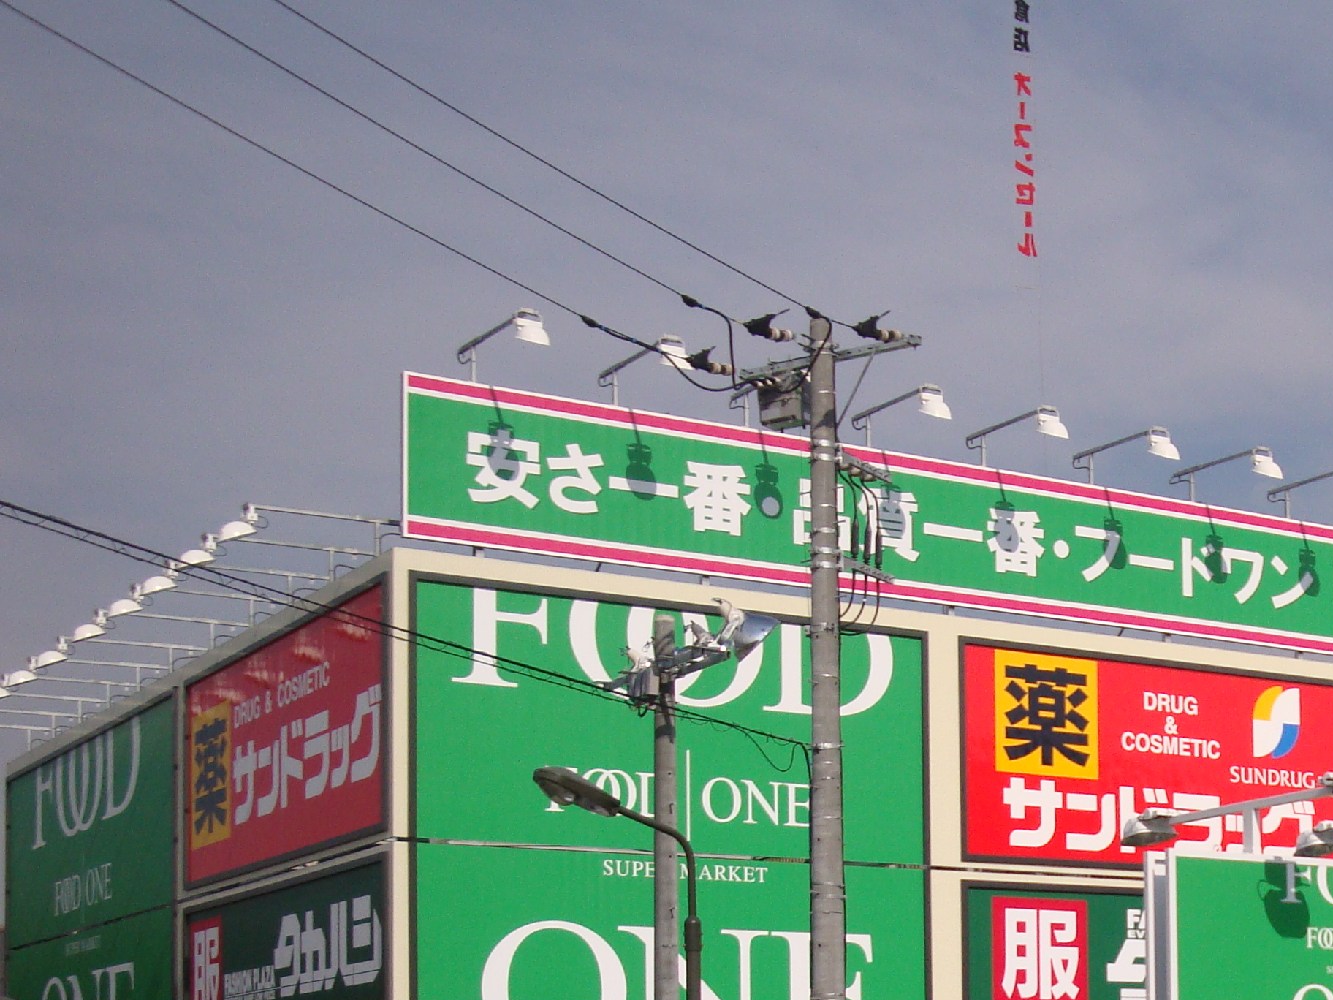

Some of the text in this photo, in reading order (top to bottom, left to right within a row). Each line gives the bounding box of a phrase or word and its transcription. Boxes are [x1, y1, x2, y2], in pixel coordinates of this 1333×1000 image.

[234, 661, 332, 729] DRUG & COSMETIC
[1004, 664, 1091, 767] 薬
[1143, 691, 1200, 716] DRUG
[1163, 717, 1179, 736] &
[194, 717, 228, 836] 薬
[232, 683, 383, 826] サンドラッグ
[1120, 731, 1221, 760] COSMETIC
[1229, 765, 1315, 790] SUNDRUG
[32, 715, 141, 850] FOOD
[602, 858, 656, 878] SUPE
[1001, 907, 1080, 1000] 服
